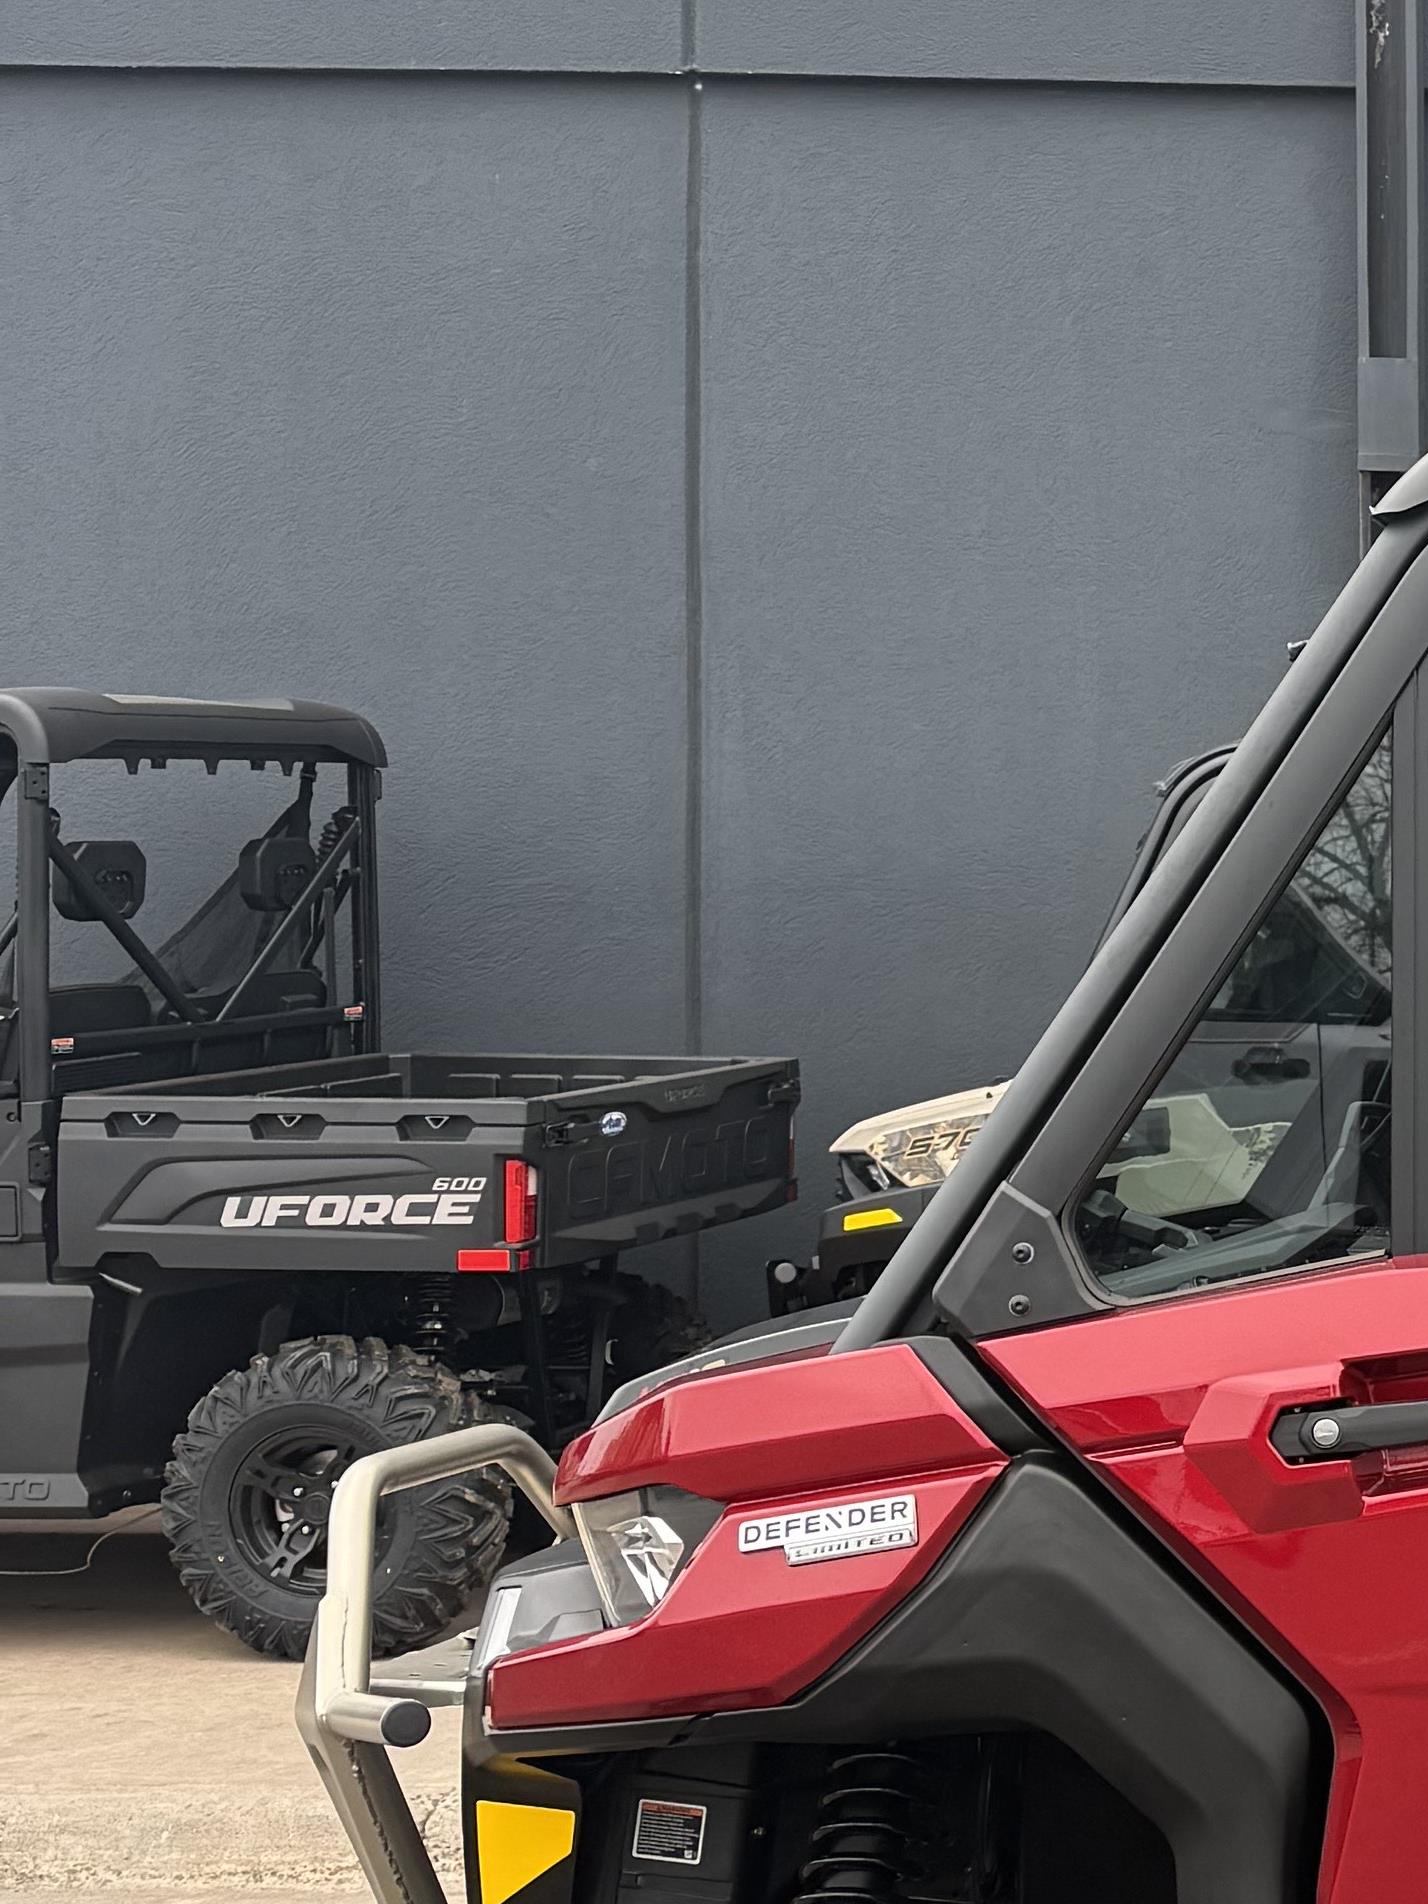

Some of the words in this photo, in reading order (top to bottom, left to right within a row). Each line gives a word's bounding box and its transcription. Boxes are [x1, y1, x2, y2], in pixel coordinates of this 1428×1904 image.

[432, 1177, 487, 1191] 600
[220, 1193, 482, 1228] UFORCE
[743, 1500, 909, 1545] DEFENDER
